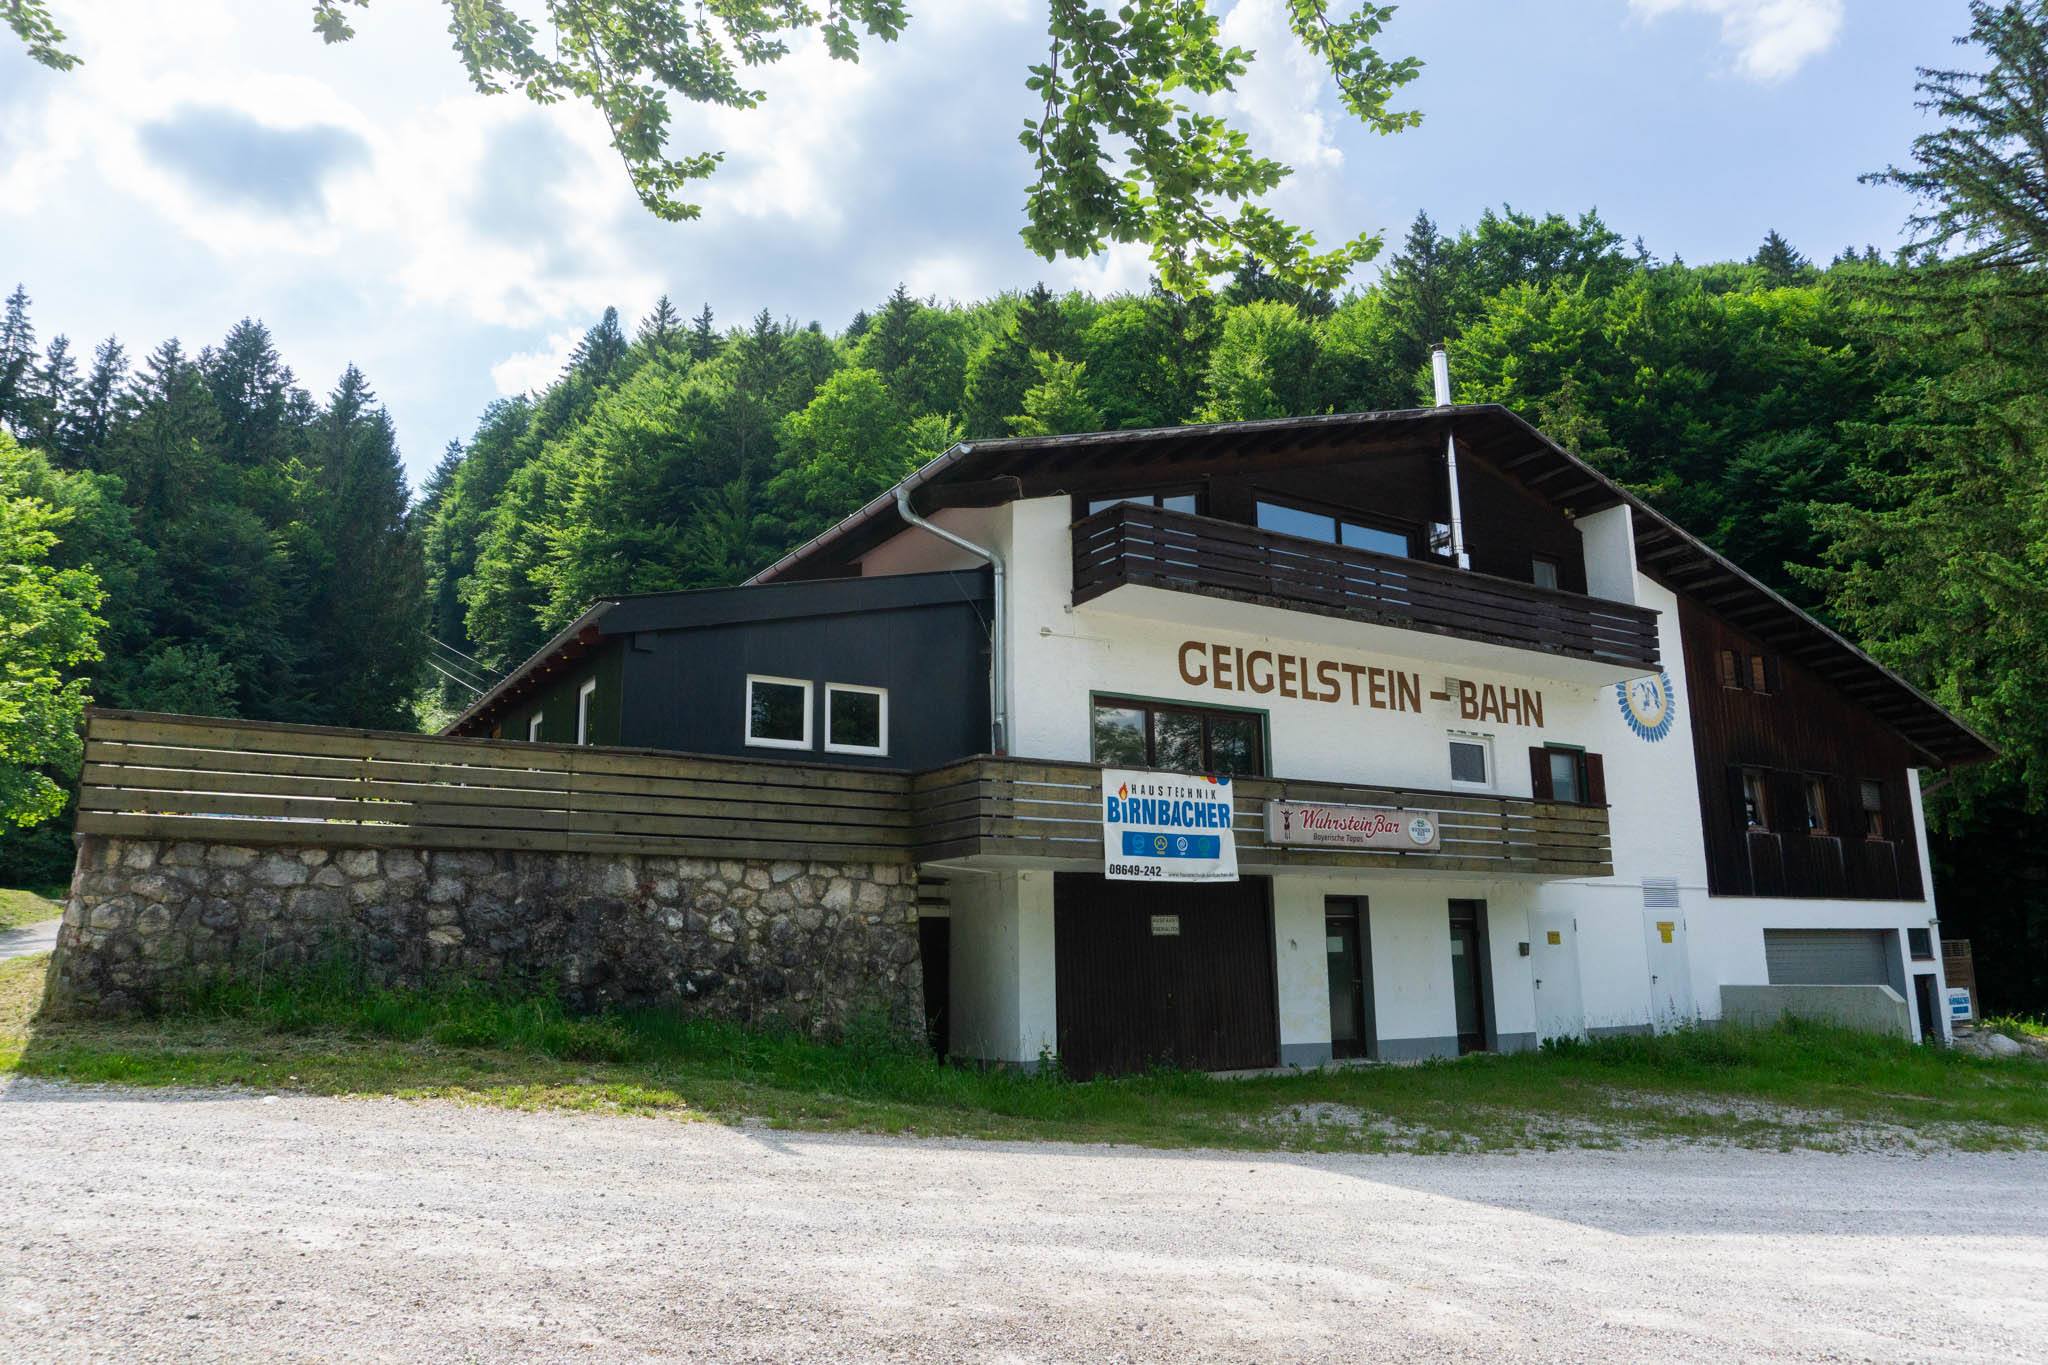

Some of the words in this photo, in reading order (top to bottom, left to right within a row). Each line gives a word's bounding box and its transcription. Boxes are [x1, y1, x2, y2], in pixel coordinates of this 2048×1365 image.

[1178, 640, 1422, 713] GEIGELSTEIN
[1459, 679, 1544, 728] BAHN
[1131, 784, 1217, 800] HAUSTECHNIK
[1108, 863, 1162, 877] 08649-242
